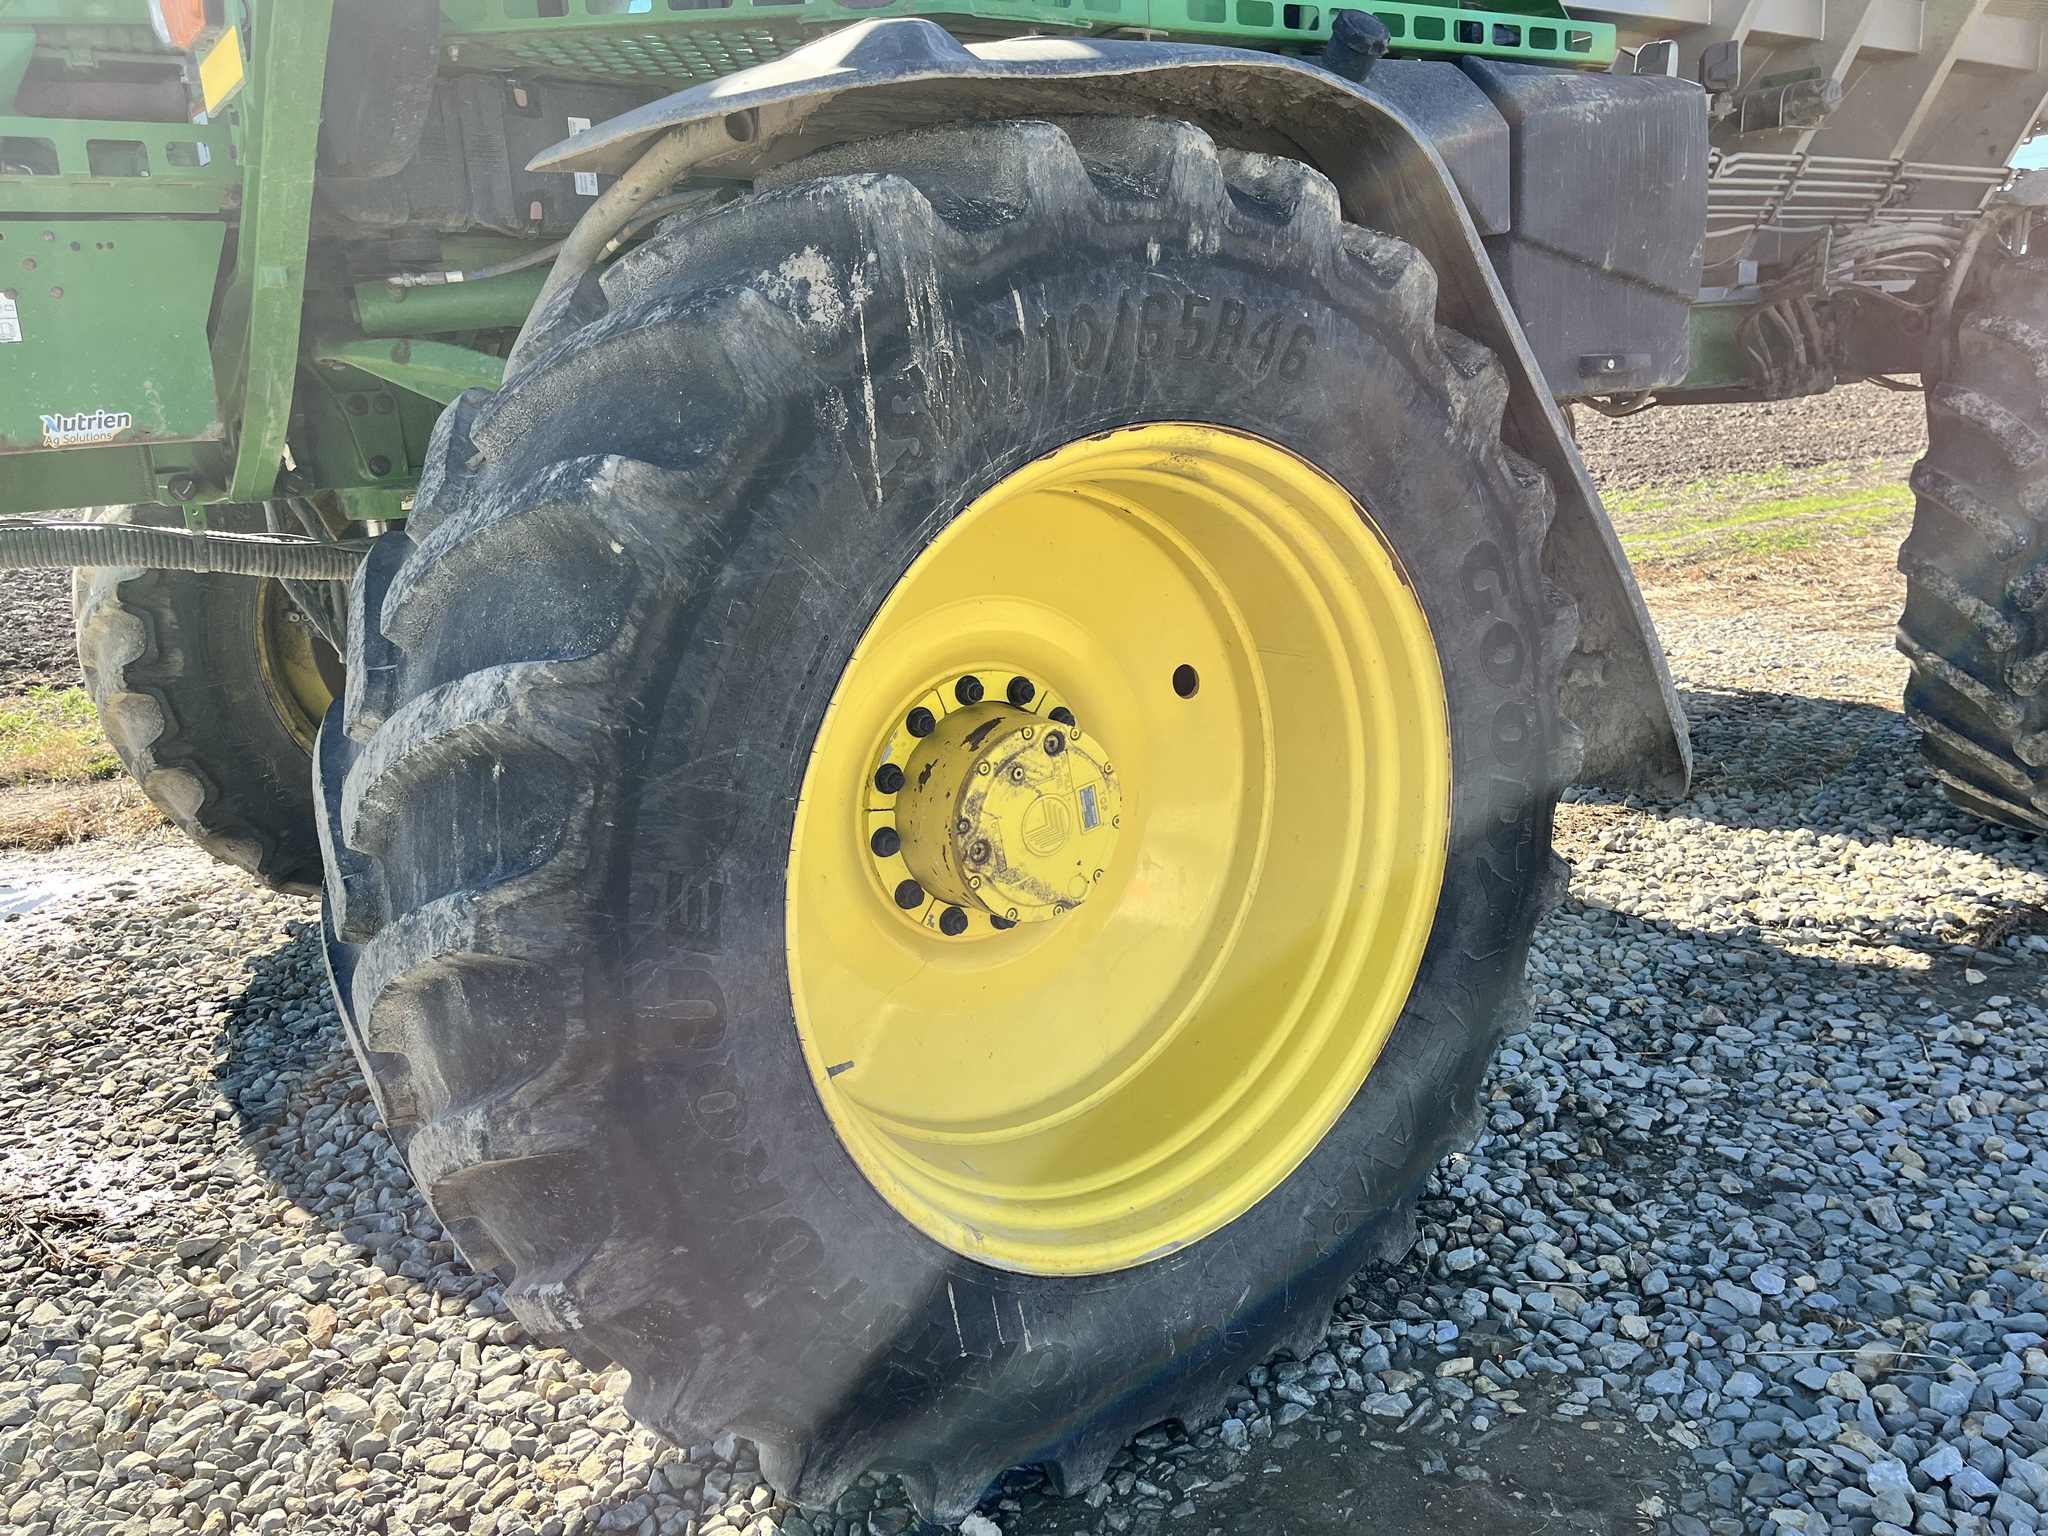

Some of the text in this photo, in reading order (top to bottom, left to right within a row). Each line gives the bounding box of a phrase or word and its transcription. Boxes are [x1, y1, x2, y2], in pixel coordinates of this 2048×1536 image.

[44, 411, 130, 434] Nutrien
[45, 432, 112, 446] Ag Solutions
[1063, 772, 1072, 791] FILL
[1098, 788, 1108, 812] TOP
[1303, 537, 1532, 1259] GOODYEAR
